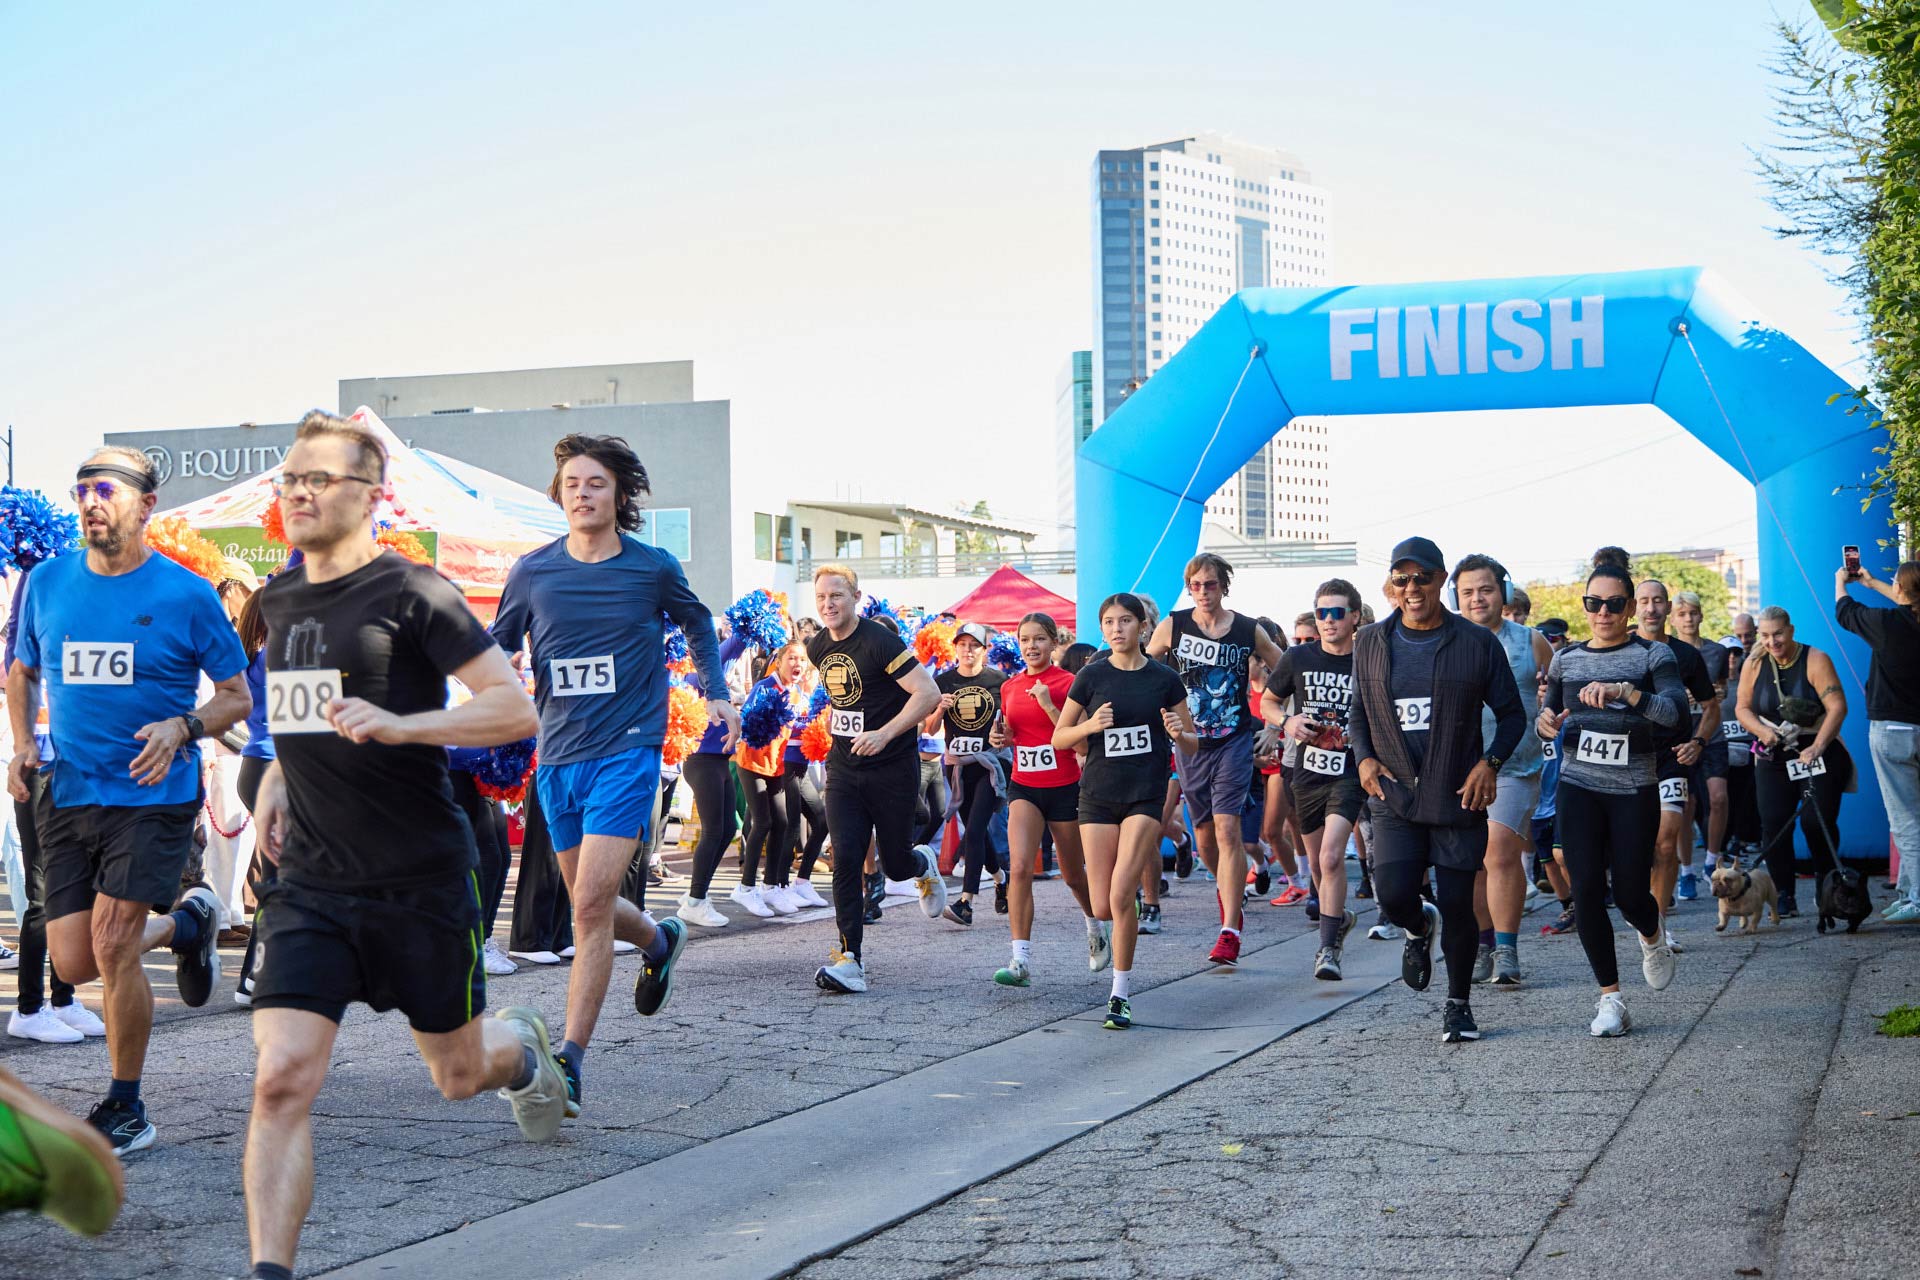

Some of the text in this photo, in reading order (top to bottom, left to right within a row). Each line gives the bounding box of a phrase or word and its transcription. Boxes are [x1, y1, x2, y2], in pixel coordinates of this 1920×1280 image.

[1329, 295, 1604, 380] FINISH
[180, 447, 286, 481] EQUITY
[1180, 638, 1216, 660] 300
[68, 649, 129, 678] 176
[557, 662, 611, 689] 175
[271, 681, 334, 722] 208
[1304, 686, 1353, 704] TROT
[1306, 701, 1333, 709] THOUGHT
[1335, 703, 1348, 711] YOU
[833, 713, 862, 733] 296
[951, 739, 980, 753] 416
[1108, 730, 1149, 752] 215
[1581, 736, 1625, 760] 447
[1020, 749, 1053, 767] 376
[1306, 751, 1342, 772] 436
[1790, 756, 1822, 777] 144
